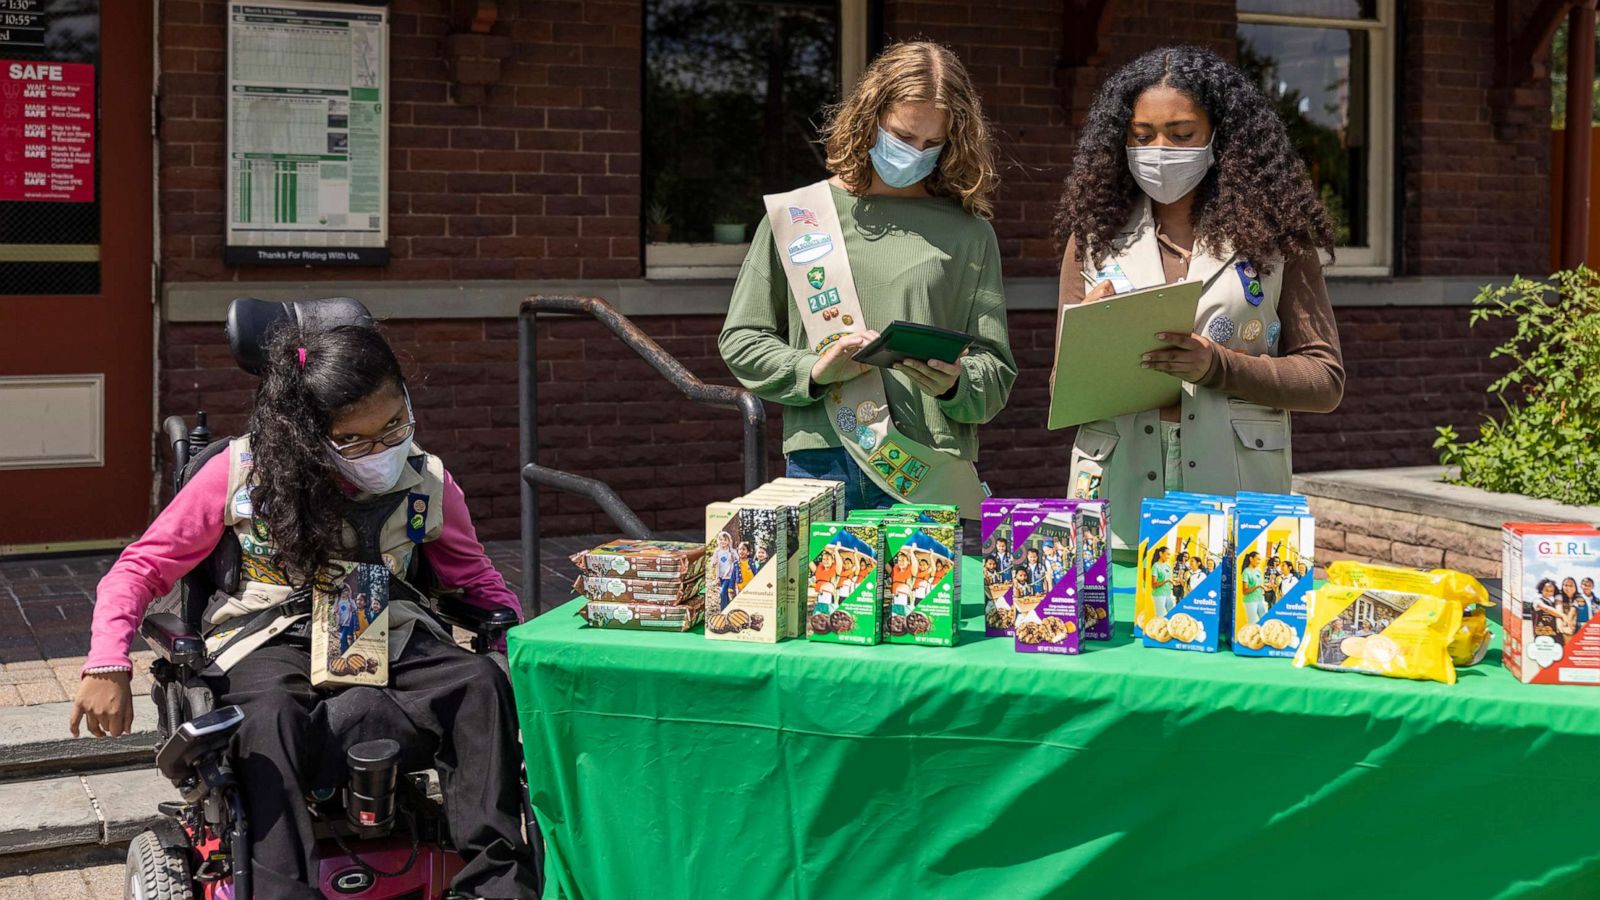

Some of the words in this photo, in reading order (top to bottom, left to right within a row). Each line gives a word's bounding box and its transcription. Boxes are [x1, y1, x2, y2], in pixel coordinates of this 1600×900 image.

[9, 64, 63, 81] SAFE
[24, 90, 47, 98] SAFE
[258, 251, 286, 259] Thanks
[302, 252, 327, 260] Riding
[347, 252, 360, 260] Us.
[810, 290, 837, 310] 205
